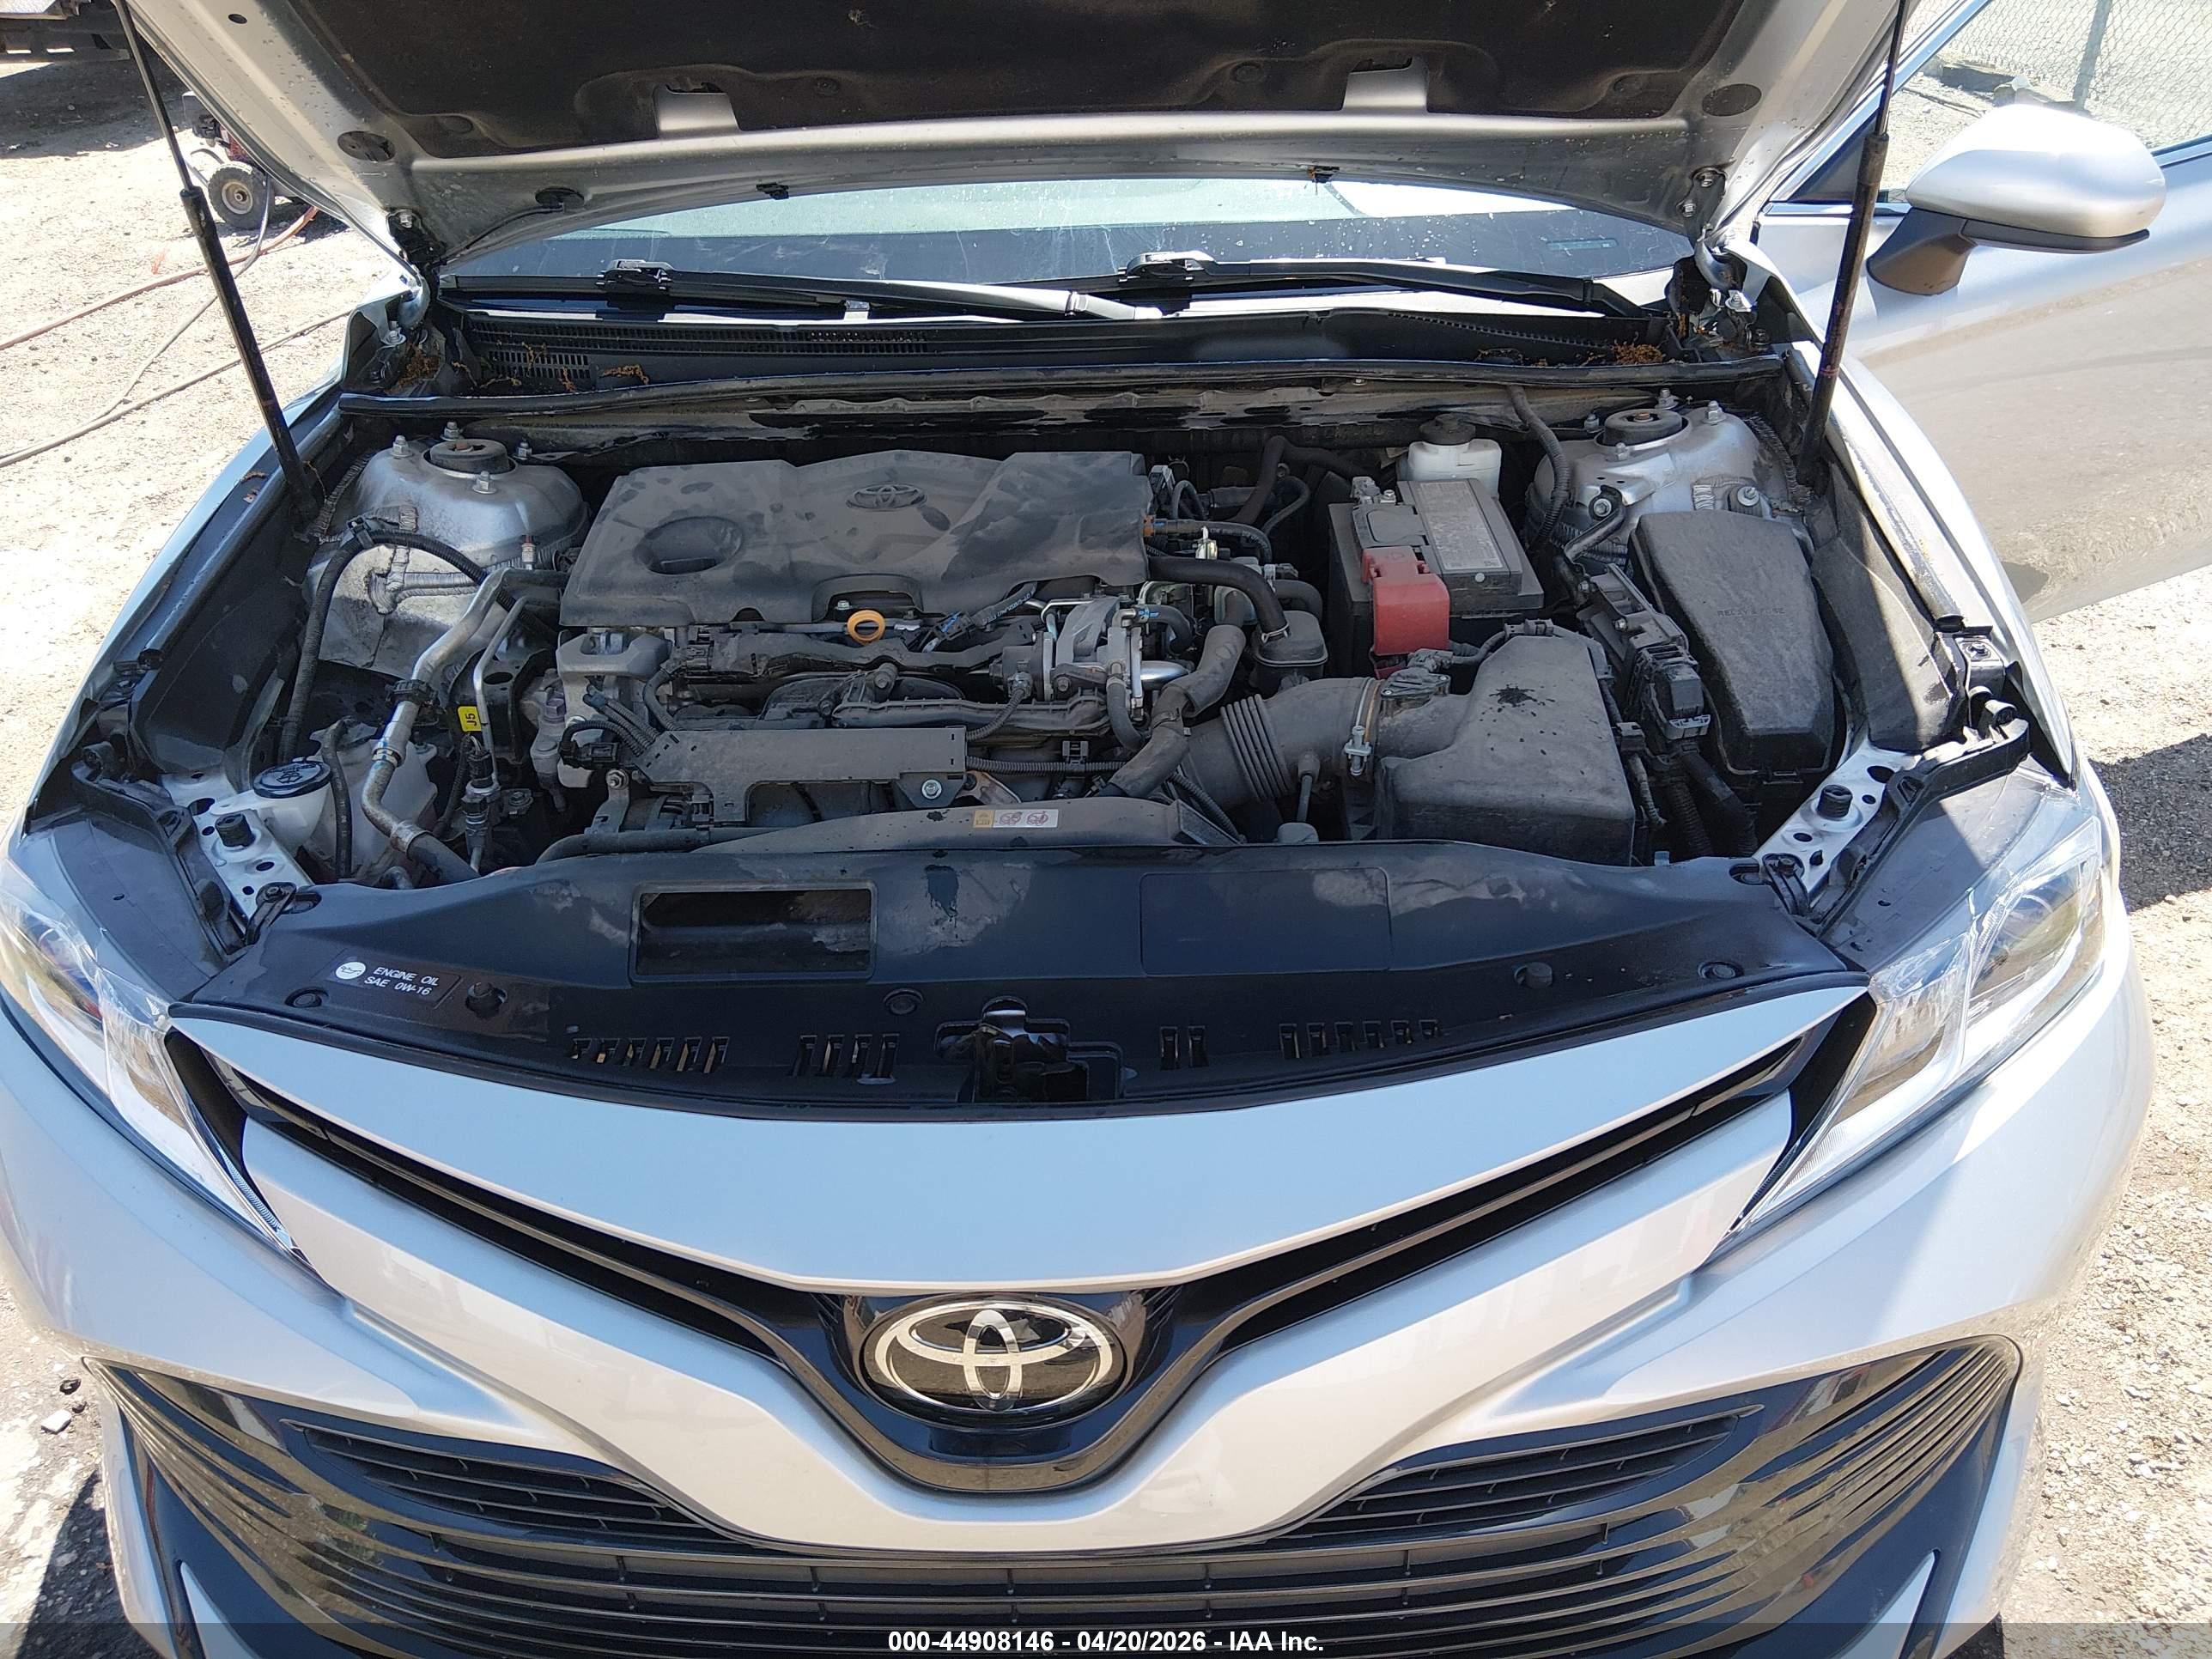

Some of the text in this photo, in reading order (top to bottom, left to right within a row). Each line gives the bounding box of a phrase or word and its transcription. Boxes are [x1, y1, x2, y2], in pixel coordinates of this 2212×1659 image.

[465, 713, 477, 726] J5
[364, 975, 432, 995] SAE 0W-16
[374, 967, 439, 987] ENGINE OIL
